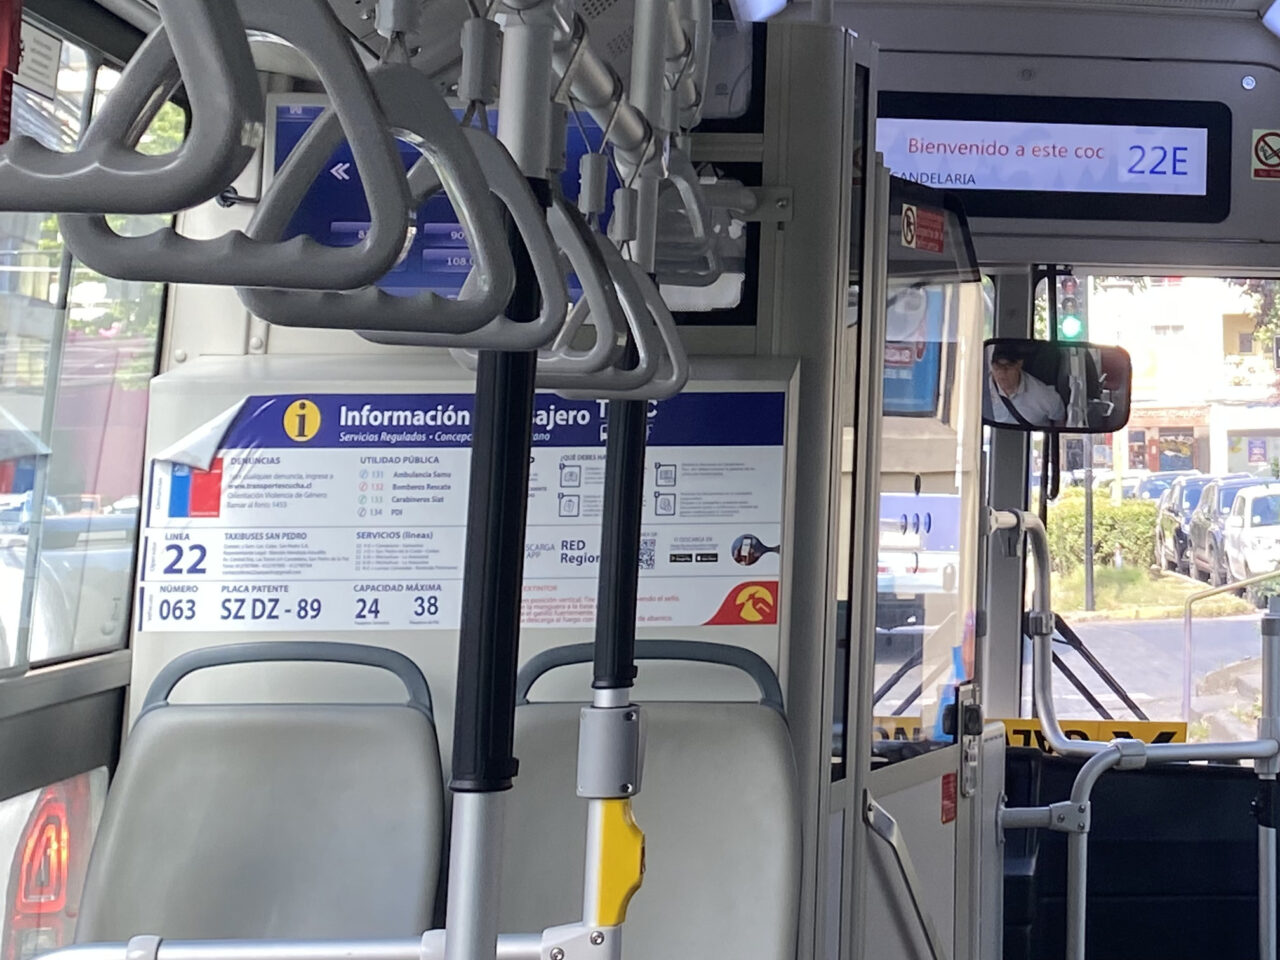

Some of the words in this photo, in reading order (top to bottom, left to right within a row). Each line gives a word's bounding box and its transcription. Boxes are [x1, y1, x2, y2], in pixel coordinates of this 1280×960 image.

[908, 137, 1009, 156] Bienvenido
[1016, 144, 1025, 157] a
[1032, 142, 1068, 158] este
[1074, 144, 1105, 159] coc
[1127, 145, 1189, 176] 22E
[339, 405, 471, 427] Información
[532, 405, 591, 431] ajero
[339, 431, 379, 442] Servicios
[381, 431, 427, 442] Regulados
[230, 457, 281, 465] DENUNCIAS
[402, 455, 440, 464] PÚBLICA
[303, 491, 327, 499] Género
[281, 532, 307, 540] PEDRO
[356, 531, 401, 540] SERVICIOS
[560, 540, 586, 551] RED
[163, 543, 207, 575] 22
[159, 585, 199, 593] NÚMERO
[221, 585, 250, 593] PLACA
[251, 585, 289, 593] PATENTE
[353, 584, 404, 592] CAPACIDAD
[405, 583, 442, 592] MÁXIMA
[159, 598, 197, 620] 063
[220, 598, 246, 620] SZ
[251, 598, 280, 620] DZ
[296, 598, 322, 620] 89
[355, 598, 380, 619] 24
[414, 595, 439, 617] 38
